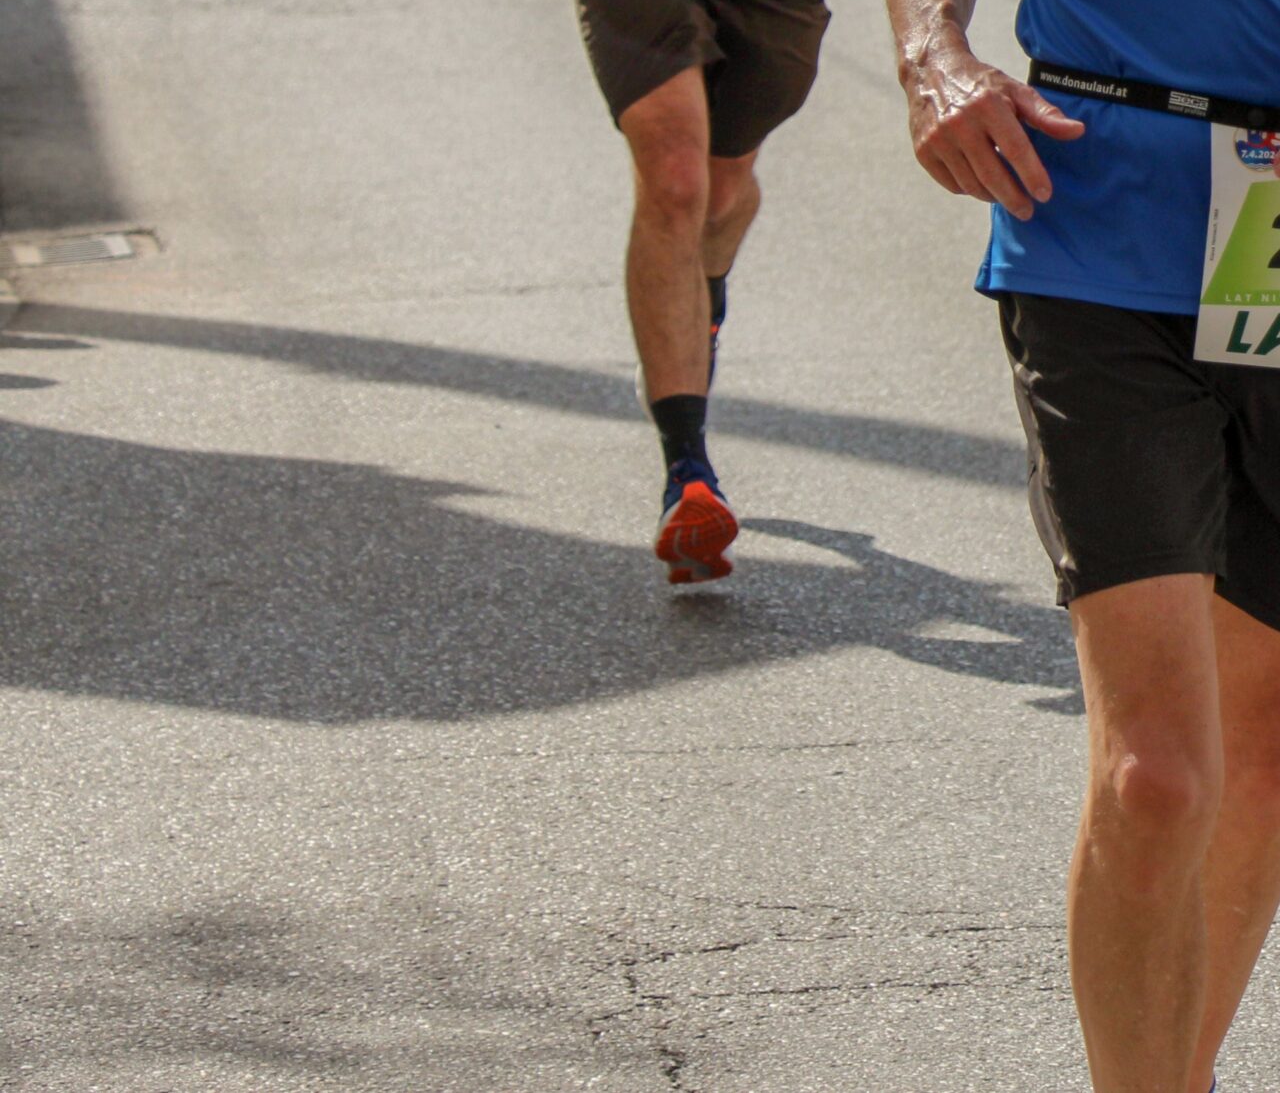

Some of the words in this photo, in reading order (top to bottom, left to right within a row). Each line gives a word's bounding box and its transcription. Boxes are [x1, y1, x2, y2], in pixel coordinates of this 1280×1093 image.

[1039, 71, 1129, 98] www.donaulauf.at
[1240, 148, 1275, 159] 7.4.202
[1225, 294, 1252, 303] LAT
